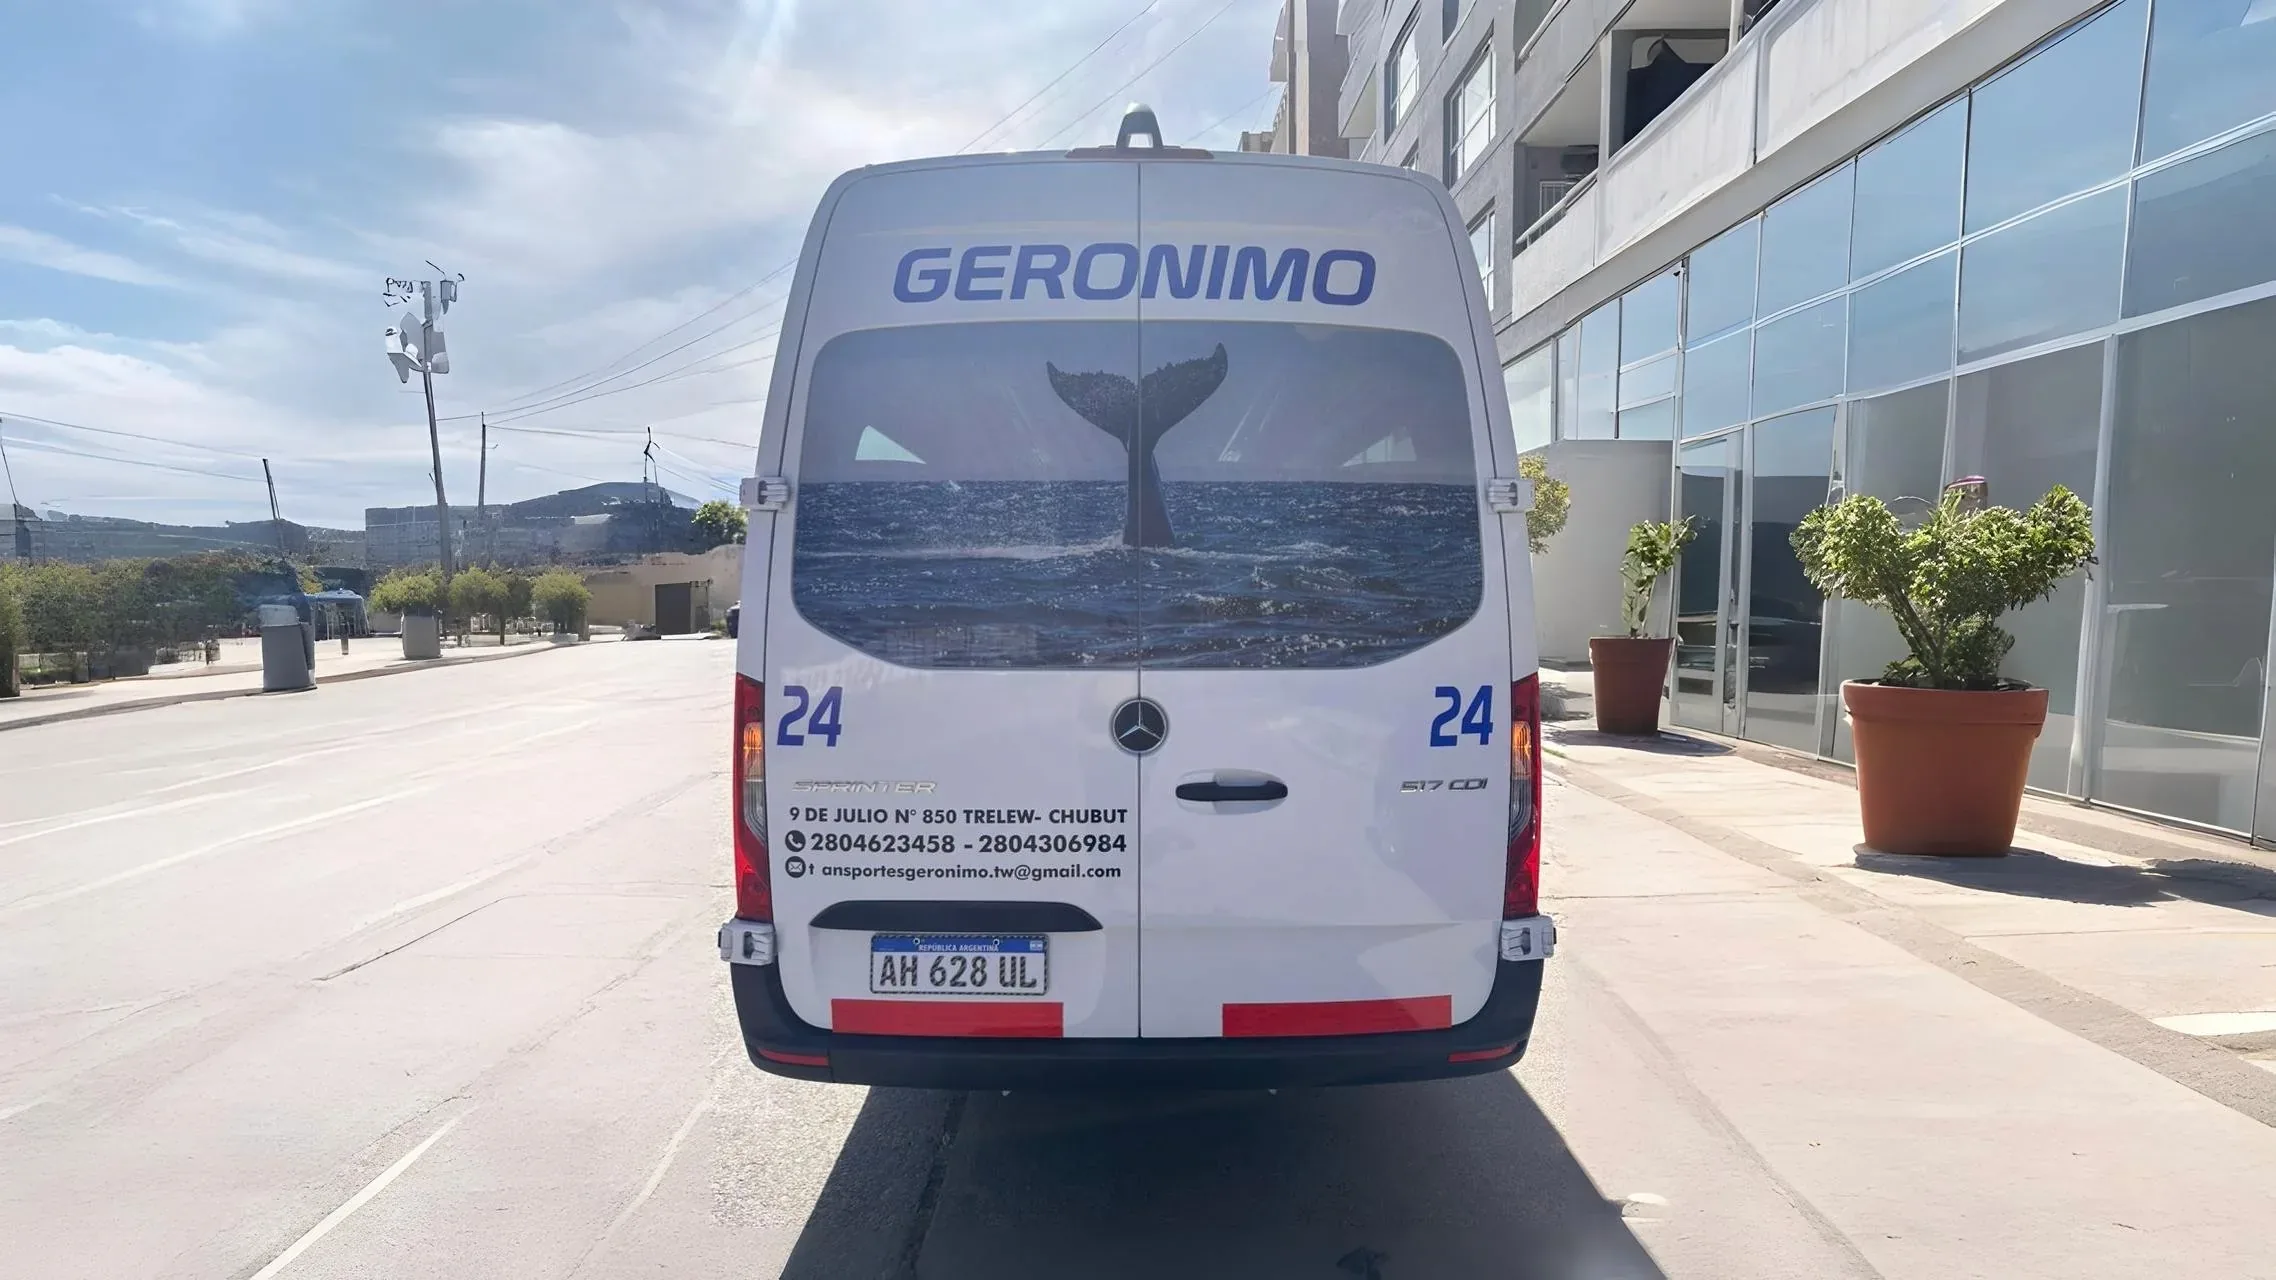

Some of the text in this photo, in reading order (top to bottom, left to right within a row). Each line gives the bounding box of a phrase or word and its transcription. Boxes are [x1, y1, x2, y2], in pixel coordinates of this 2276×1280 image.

[893, 242, 1377, 306] GERONIMO
[777, 685, 843, 747] 24
[1430, 685, 1493, 747] 24
[792, 779, 938, 793] SPRINTER
[1401, 777, 1488, 792] 517 CDI
[789, 806, 800, 821] 9
[805, 807, 828, 822] DE
[833, 808, 888, 823] JULIO
[922, 809, 957, 824] 850
[963, 809, 1041, 824] TRELEW-
[1049, 809, 1128, 824] CHUBUT
[810, 833, 955, 853] 2804623458
[978, 834, 1127, 853] 2804306984
[918, 943, 999, 952] REPÚBLICA ARGENTINA
[880, 955, 1037, 988] AH 628 UL
